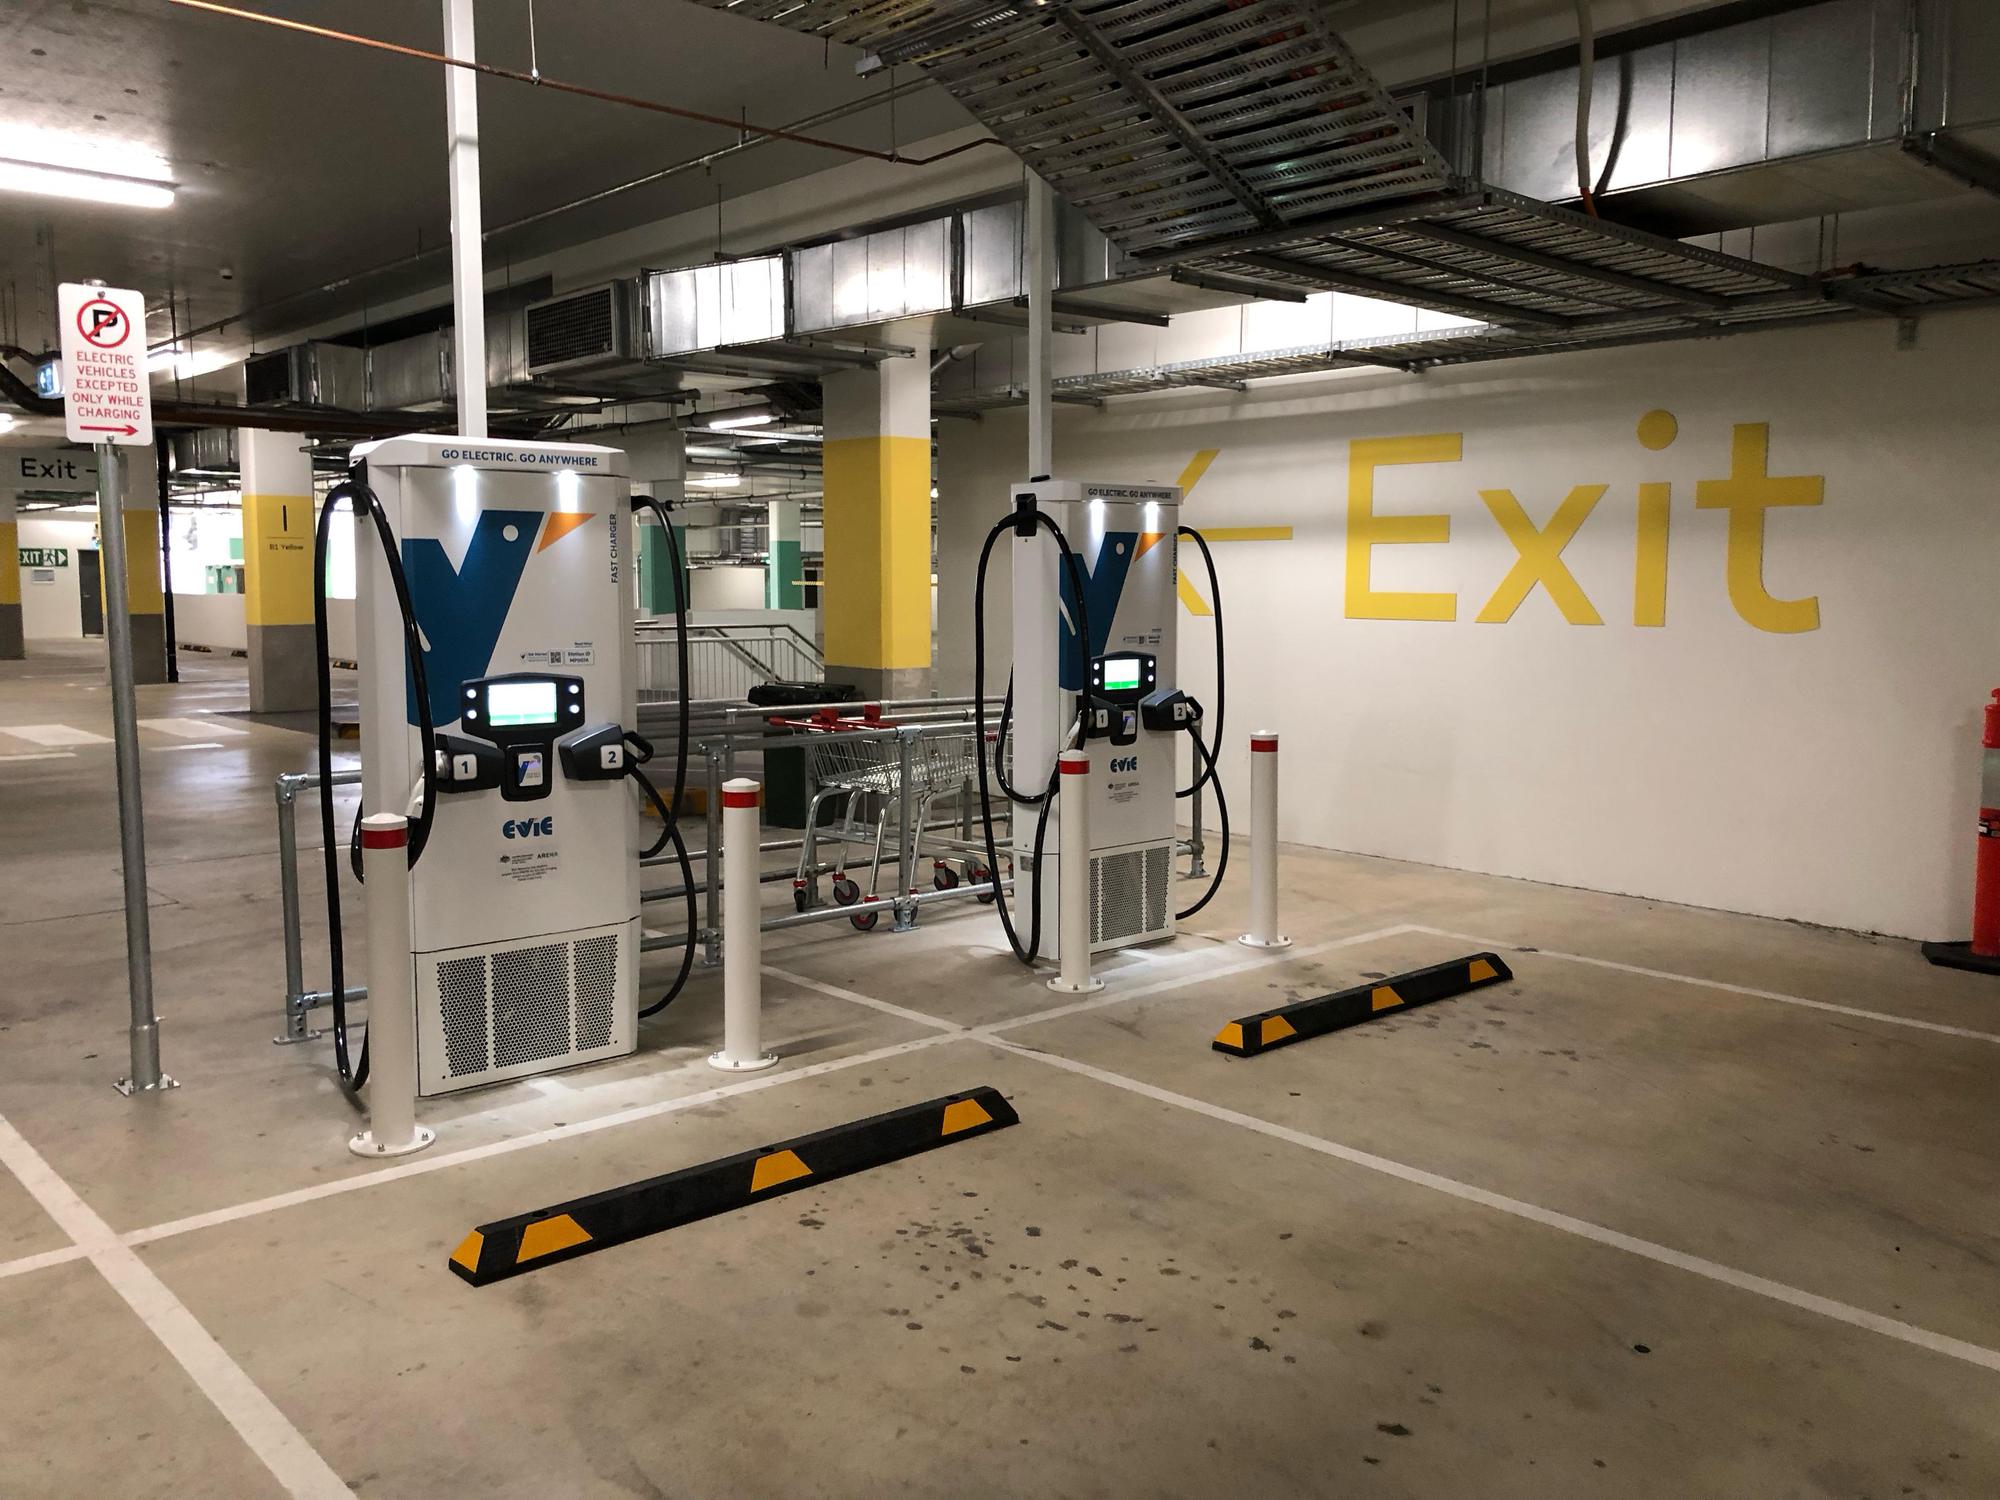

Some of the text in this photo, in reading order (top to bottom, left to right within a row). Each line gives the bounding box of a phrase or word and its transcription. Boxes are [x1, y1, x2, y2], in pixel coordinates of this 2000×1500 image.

[92, 309, 118, 338] P
[76, 351, 134, 365] ELECTRIC
[77, 365, 136, 379] VEHICLES
[76, 379, 138, 392] EXCEPTED
[72, 393, 144, 407] ONLY WHILE
[77, 406, 140, 420] CHARGING
[441, 449, 598, 466] GO ELECTRIC. GO ANYWHERE
[21, 458, 77, 479] Exit
[1088, 488, 1098, 496] GO
[1129, 490, 1138, 498] GO
[1140, 491, 1172, 499] ANYWHERE
[1344, 409, 1825, 634] Exit
[609, 513, 617, 559] CHARGER
[1100, 714, 1105, 724] 1
[1177, 707, 1183, 717] 2
[608, 751, 617, 764] 2
[460, 761, 469, 774] 1
